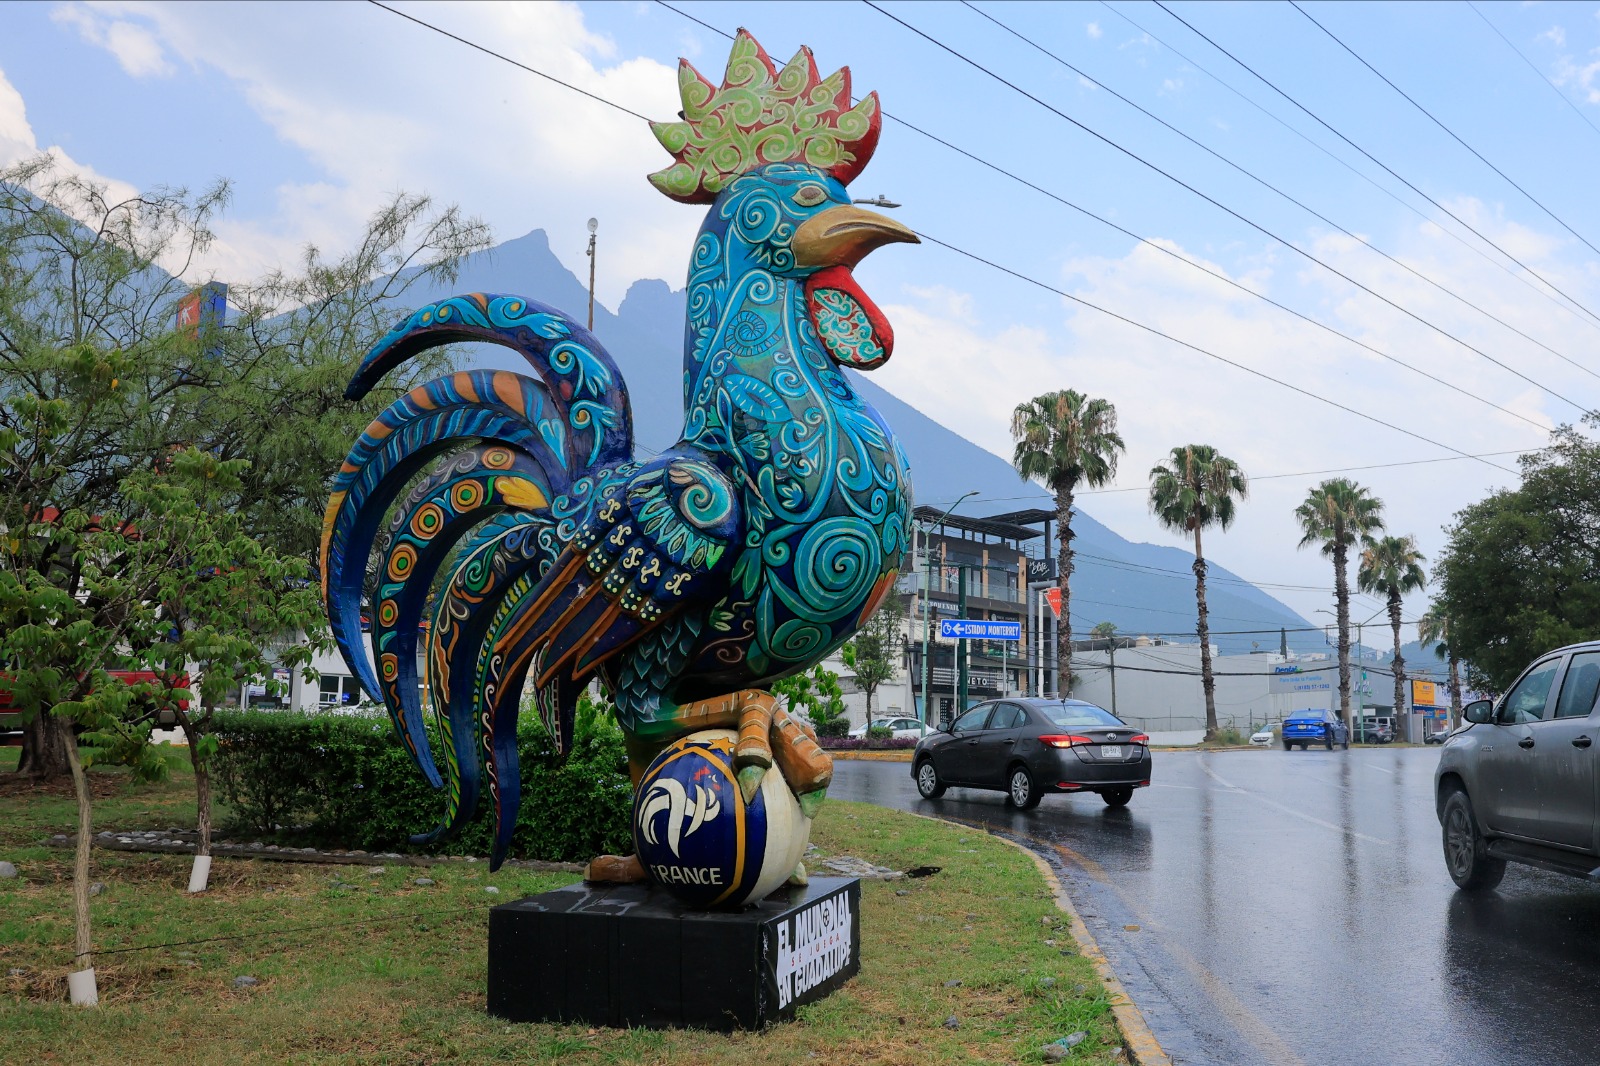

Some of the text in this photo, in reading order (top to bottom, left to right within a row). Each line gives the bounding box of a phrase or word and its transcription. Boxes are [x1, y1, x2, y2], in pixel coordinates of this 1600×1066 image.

[964, 624, 1019, 636] ESTADIO MONTERREY
[650, 864, 723, 885] FRANCE
[777, 890, 852, 956] EL MUNDIAL
[791, 932, 840, 967] SE JUEGA
[778, 941, 852, 1010] EN GUADALUPE
